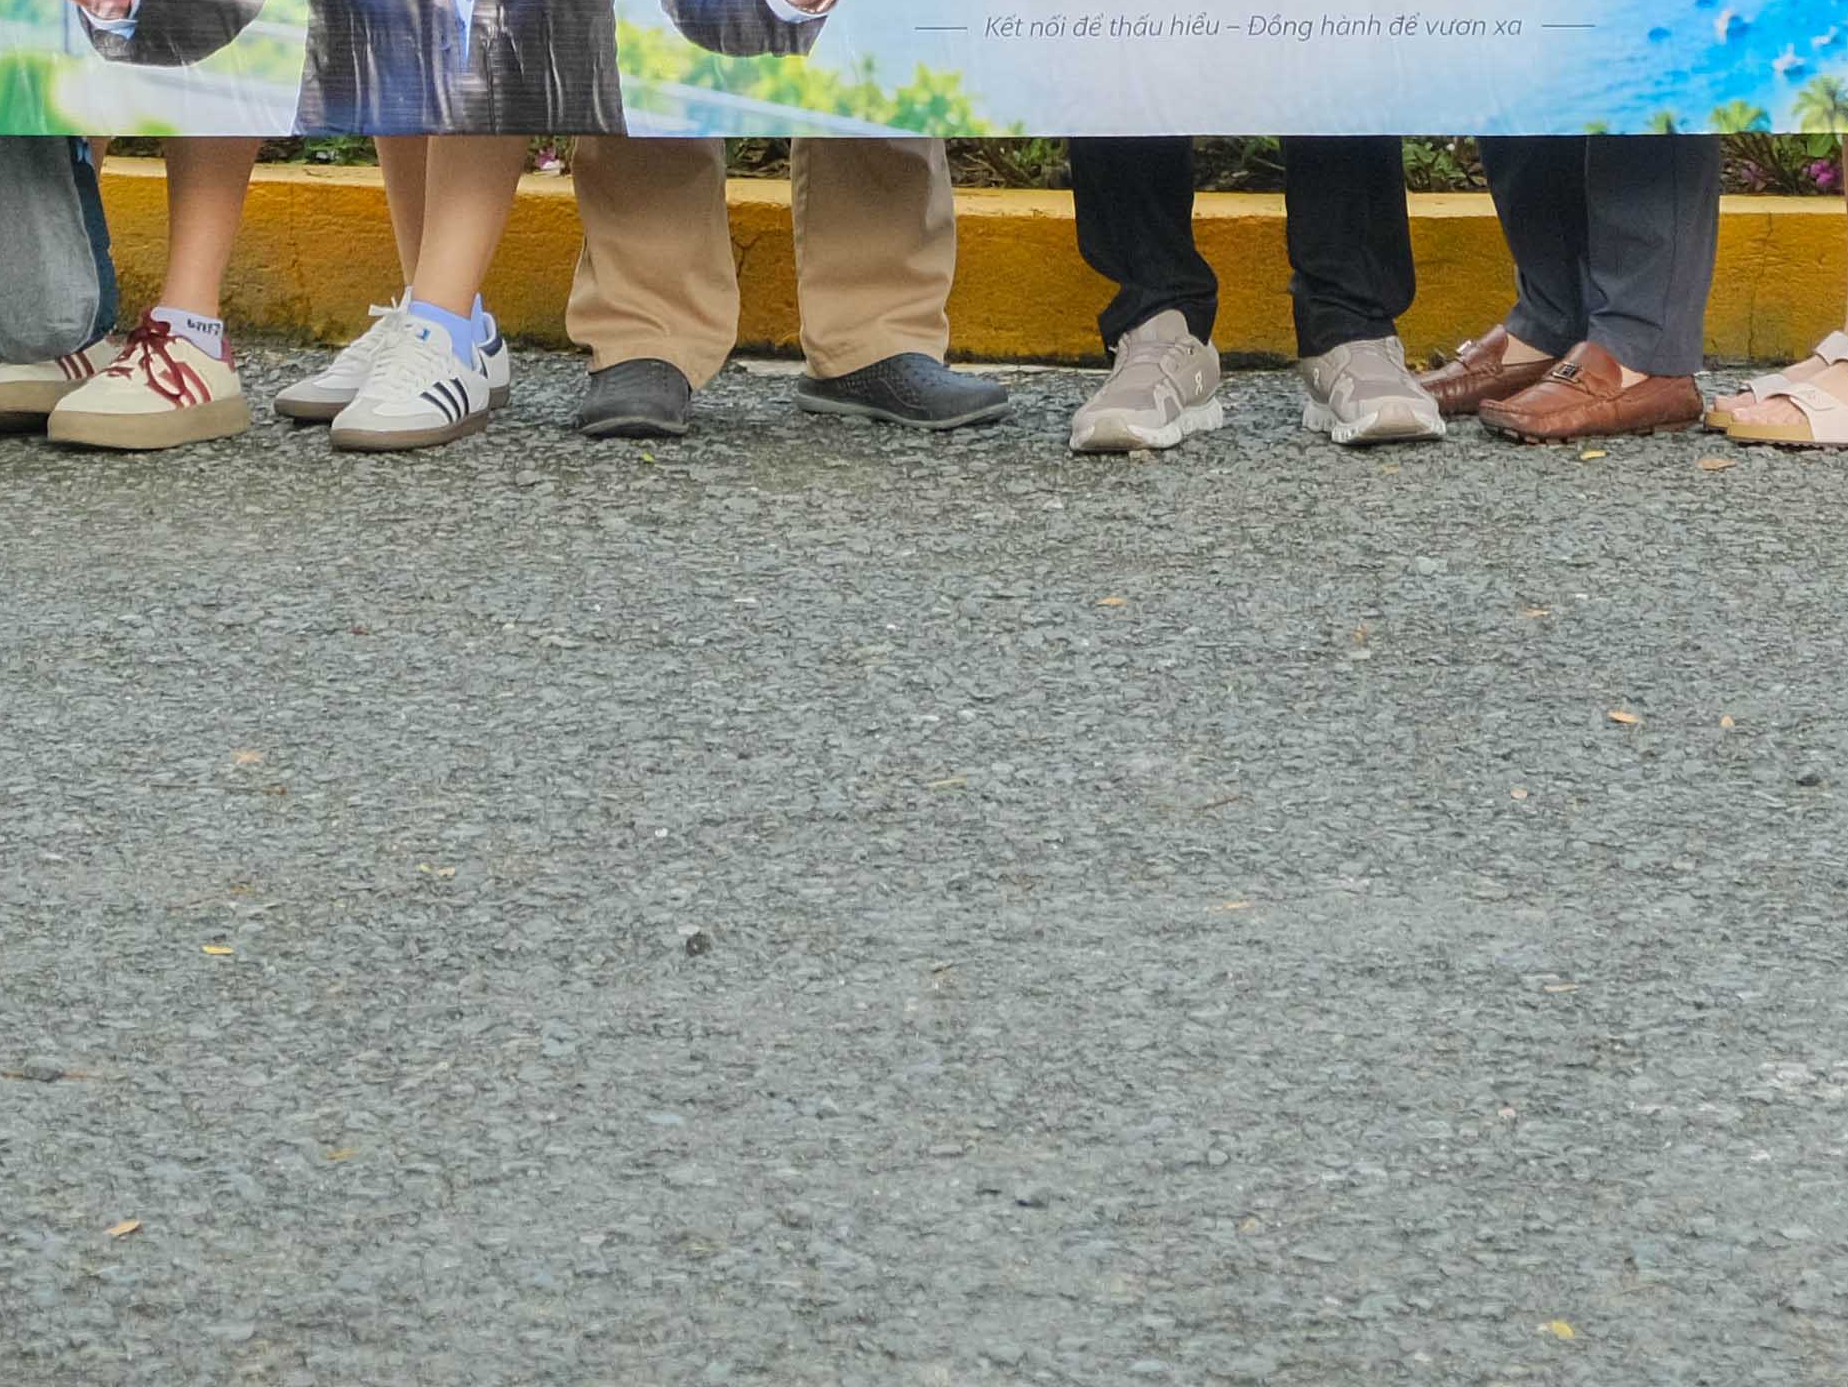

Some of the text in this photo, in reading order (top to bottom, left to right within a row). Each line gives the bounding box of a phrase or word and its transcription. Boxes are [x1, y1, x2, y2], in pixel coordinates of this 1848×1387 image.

[984, 16, 1023, 38] Kết
[1029, 14, 1067, 37] nối
[1072, 13, 1104, 37] để
[1109, 14, 1164, 37] thấu
[1169, 11, 1220, 36] hiểu
[1248, 13, 1314, 42] Đồng
[1320, 14, 1382, 36] hành
[1388, 12, 1421, 36] để
[1425, 18, 1487, 36] vươn
[1492, 19, 1522, 36] xa
